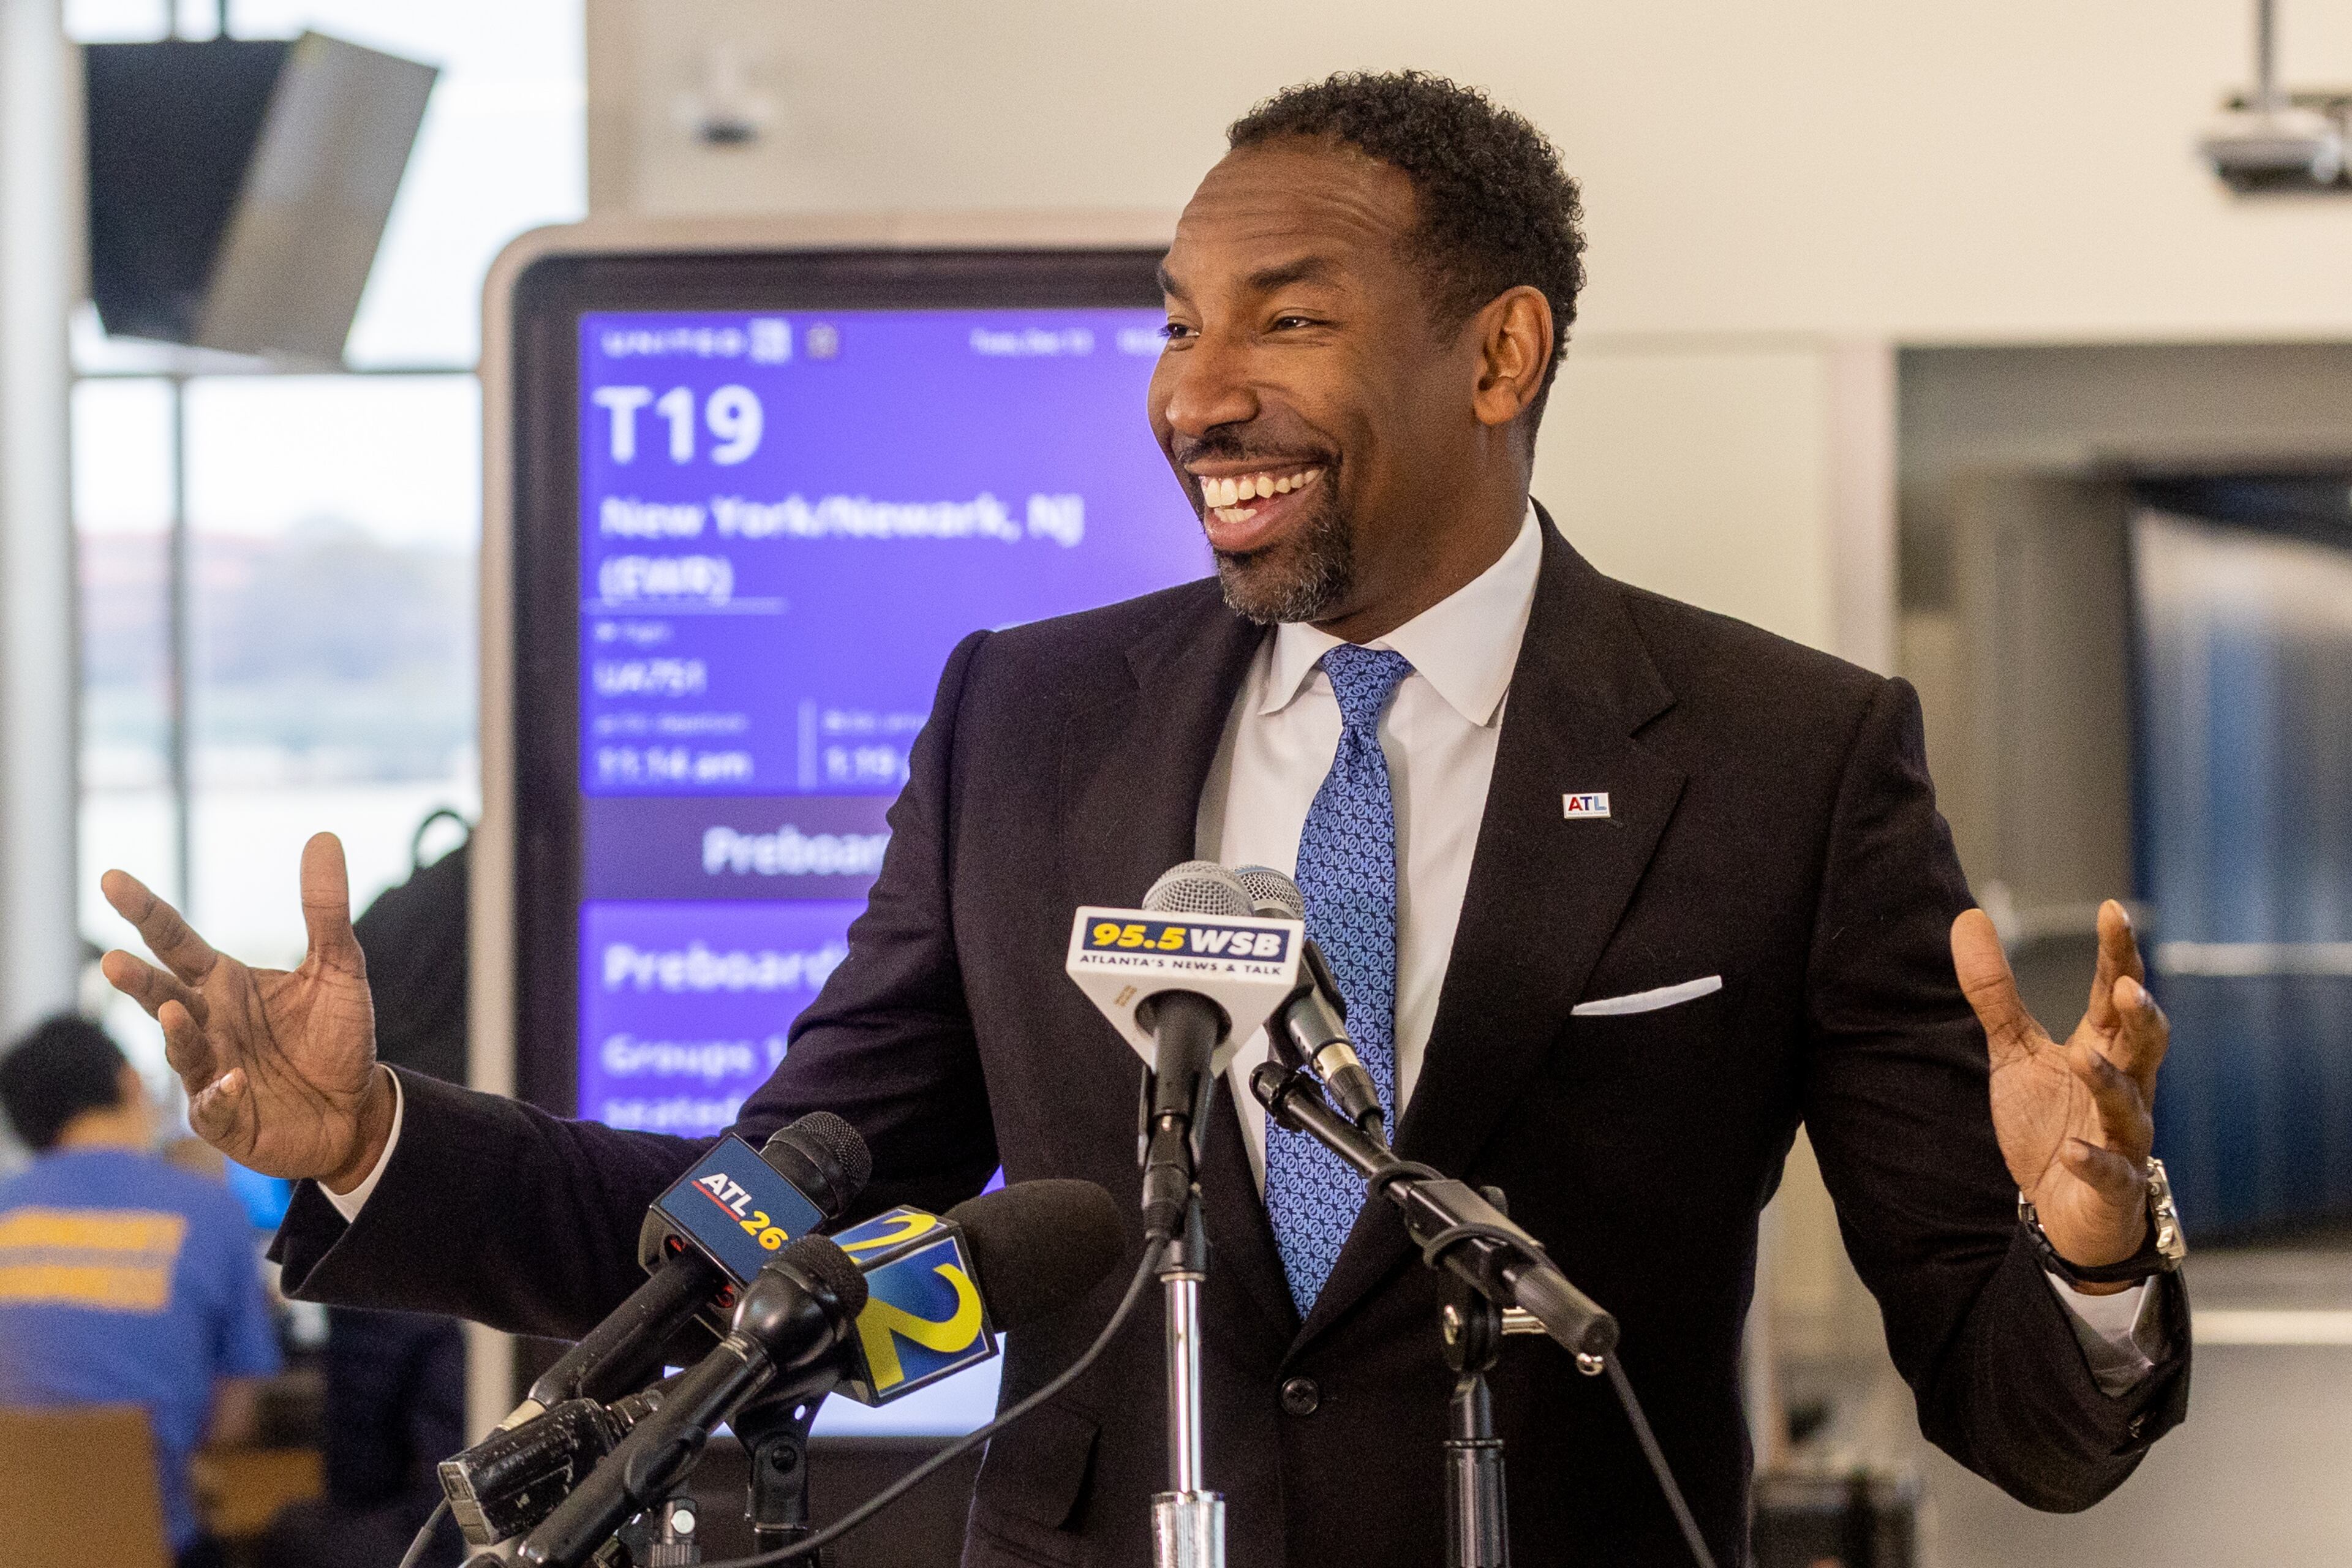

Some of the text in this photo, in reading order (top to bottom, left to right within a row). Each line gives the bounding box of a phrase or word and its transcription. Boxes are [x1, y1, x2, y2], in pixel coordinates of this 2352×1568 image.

[592, 383, 763, 466] T19
[600, 496, 705, 537] New
[1027, 494, 1085, 548] NJ
[1568, 796, 1607, 811] ATL
[1092, 922, 1282, 957] 95.5 WSB
[1080, 954, 1281, 976] ATLANTA'S NEWS & TALK
[856, 1263, 982, 1390] 2
